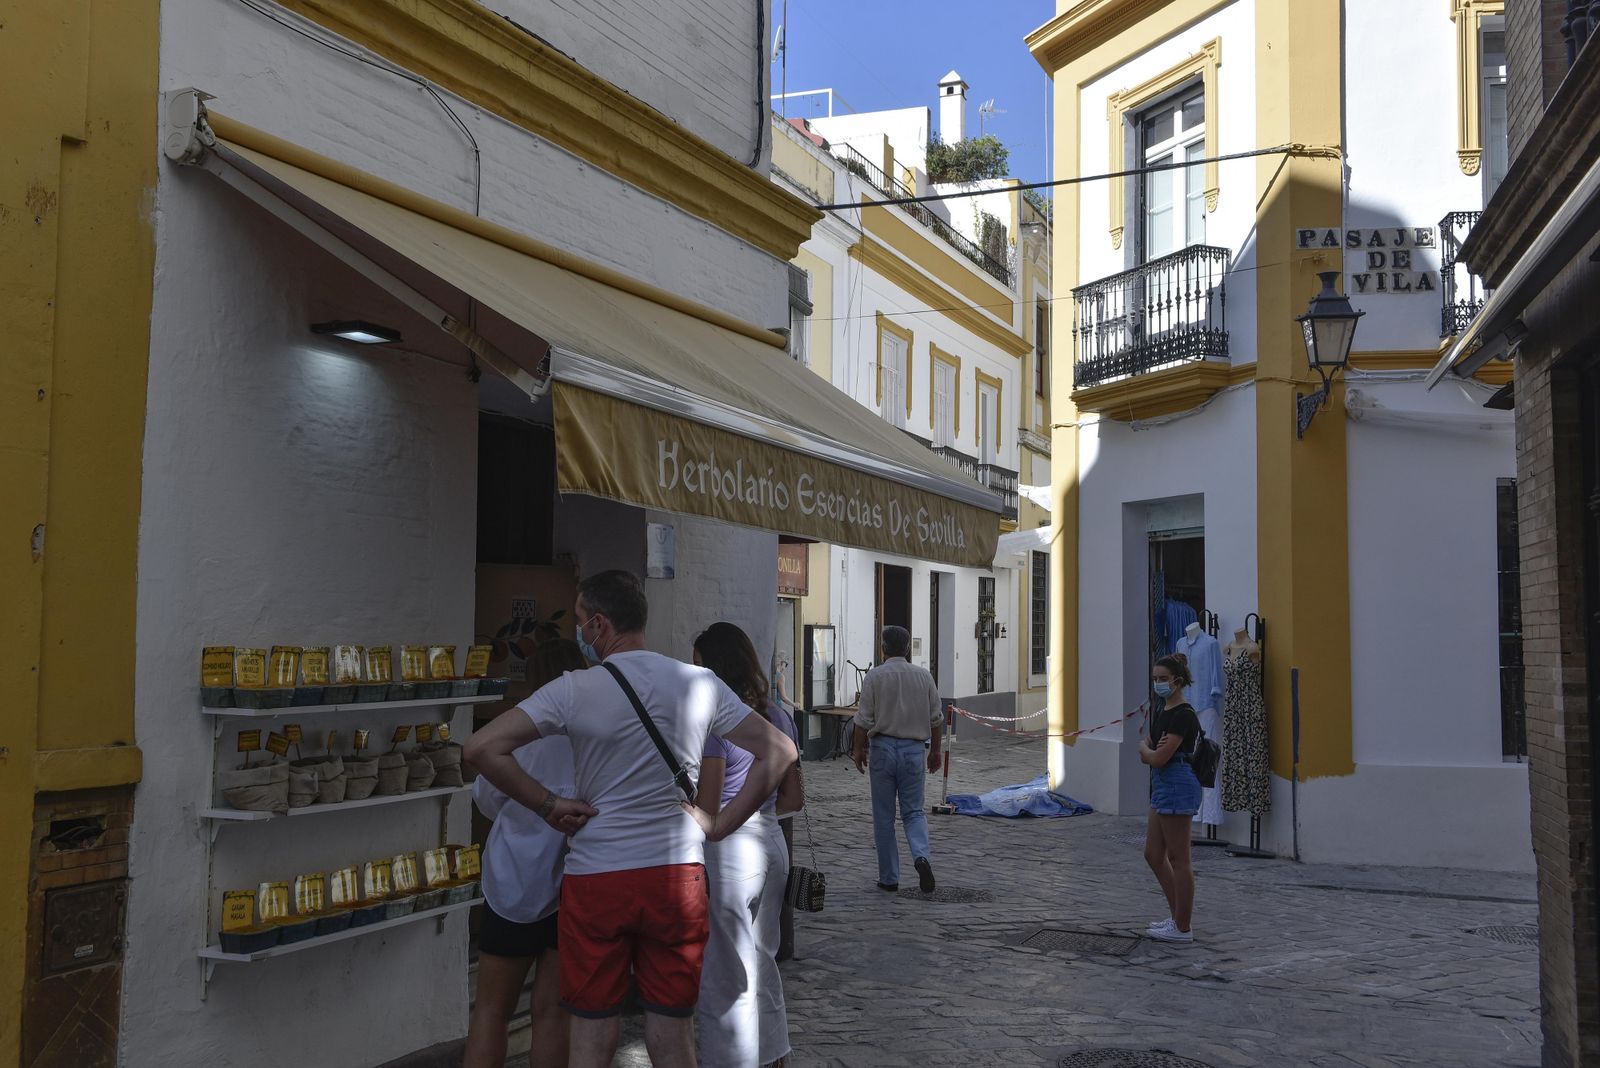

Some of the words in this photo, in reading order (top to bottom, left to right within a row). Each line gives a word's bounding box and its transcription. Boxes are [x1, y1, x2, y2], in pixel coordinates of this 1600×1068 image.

[1298, 228, 1434, 249] PASAJE
[1367, 250, 1411, 270] DE
[1352, 272, 1435, 293] VILA
[657, 440, 790, 511] Herbolario
[797, 473, 883, 529] Esencias
[889, 499, 912, 539] De
[917, 506, 967, 549] Sevilla
